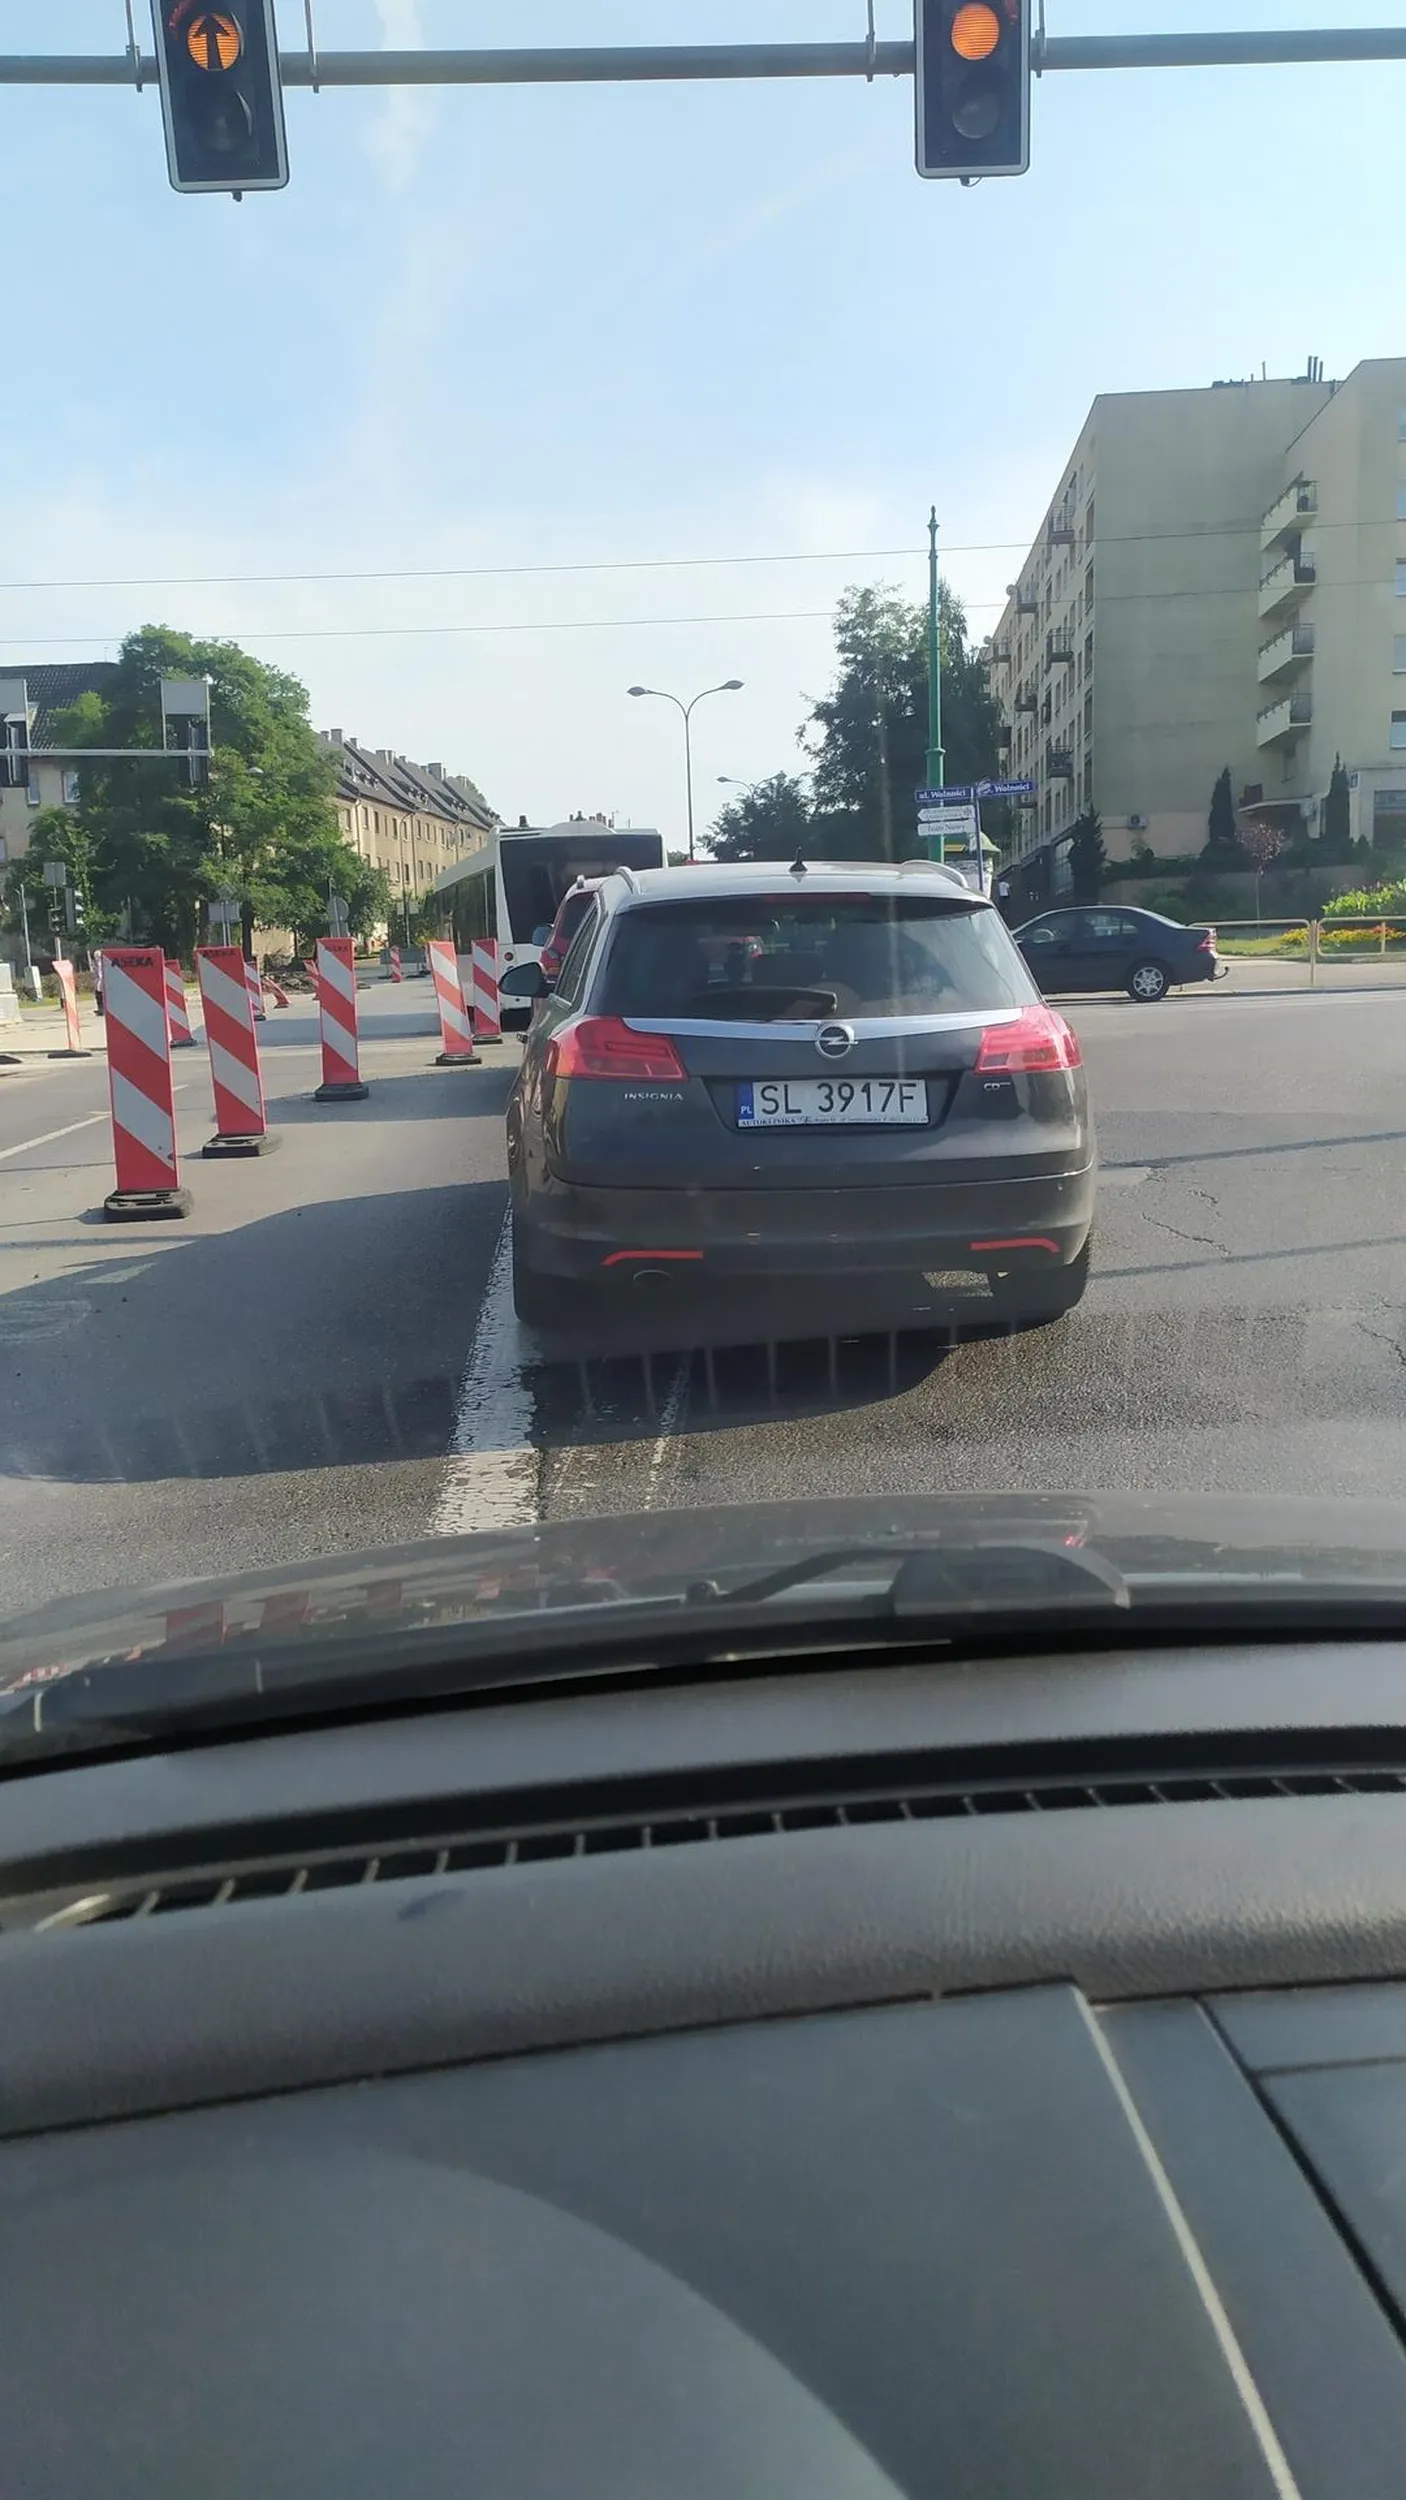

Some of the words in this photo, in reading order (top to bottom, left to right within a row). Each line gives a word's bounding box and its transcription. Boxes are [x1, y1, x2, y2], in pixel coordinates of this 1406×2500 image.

[624, 1093, 684, 1101] INSIGNIA
[761, 1084, 802, 1114] SL
[817, 1082, 917, 1112] 3917F
[741, 1105, 752, 1114] PL
